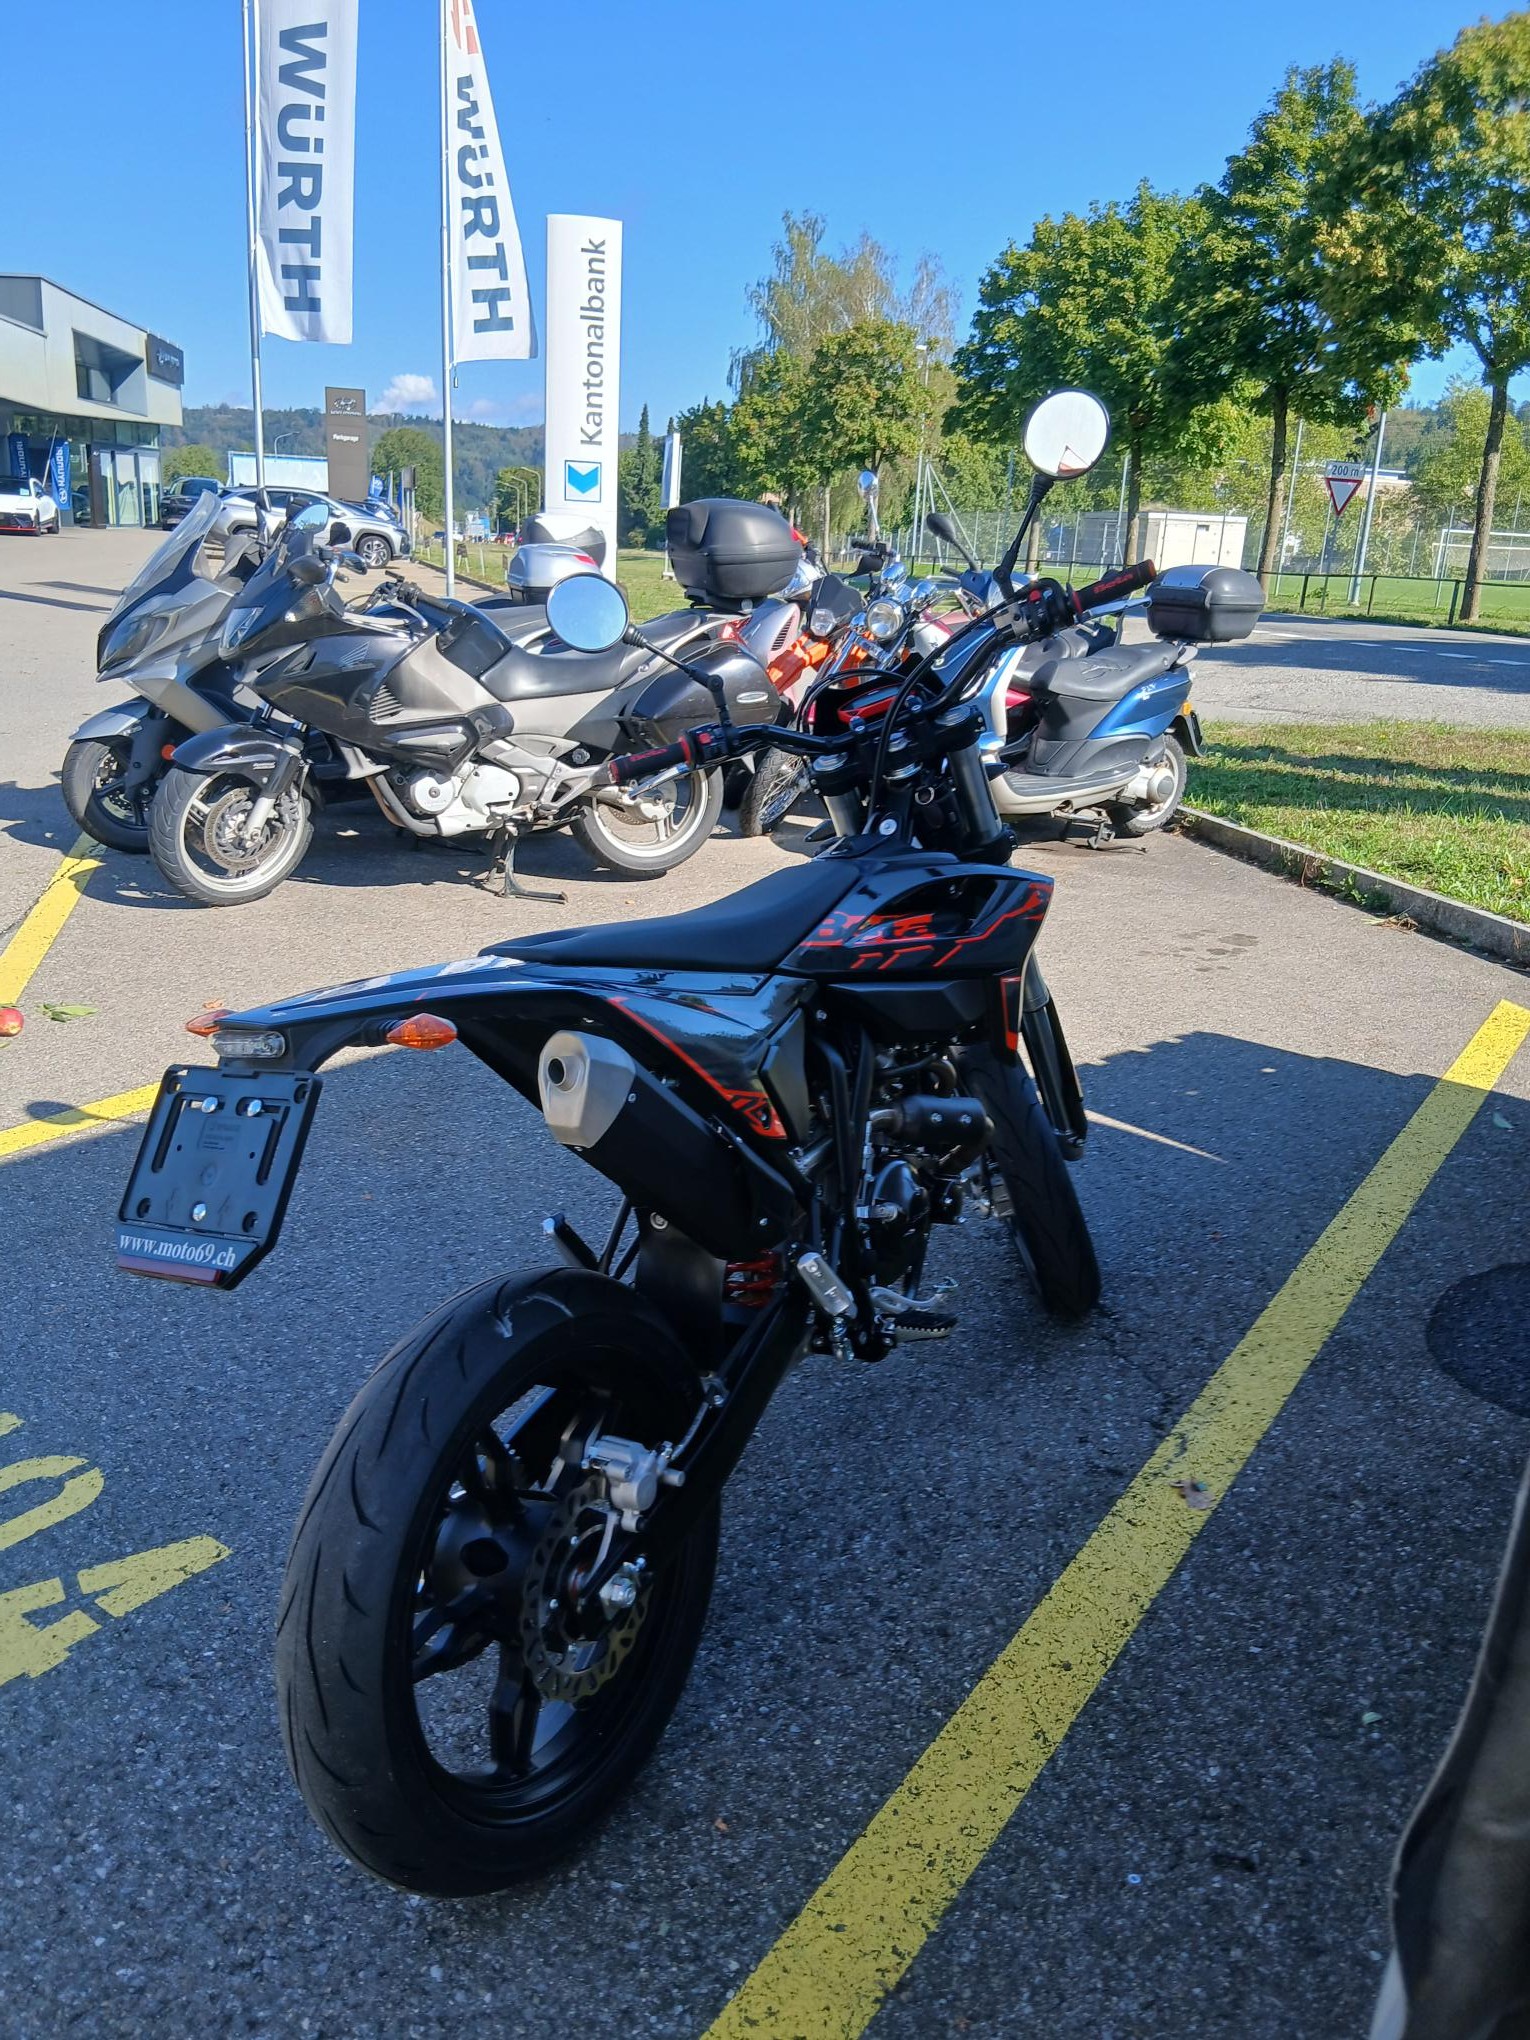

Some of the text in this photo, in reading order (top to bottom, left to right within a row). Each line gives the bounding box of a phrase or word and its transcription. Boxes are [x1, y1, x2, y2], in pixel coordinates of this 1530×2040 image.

[277, 21, 328, 313] WÜRTH
[457, 74, 515, 334] WÜRTH
[580, 238, 606, 446] Kantonalbank
[1331, 464, 1360, 477] 200 m
[119, 1233, 236, 1268] www.moto69.ch
